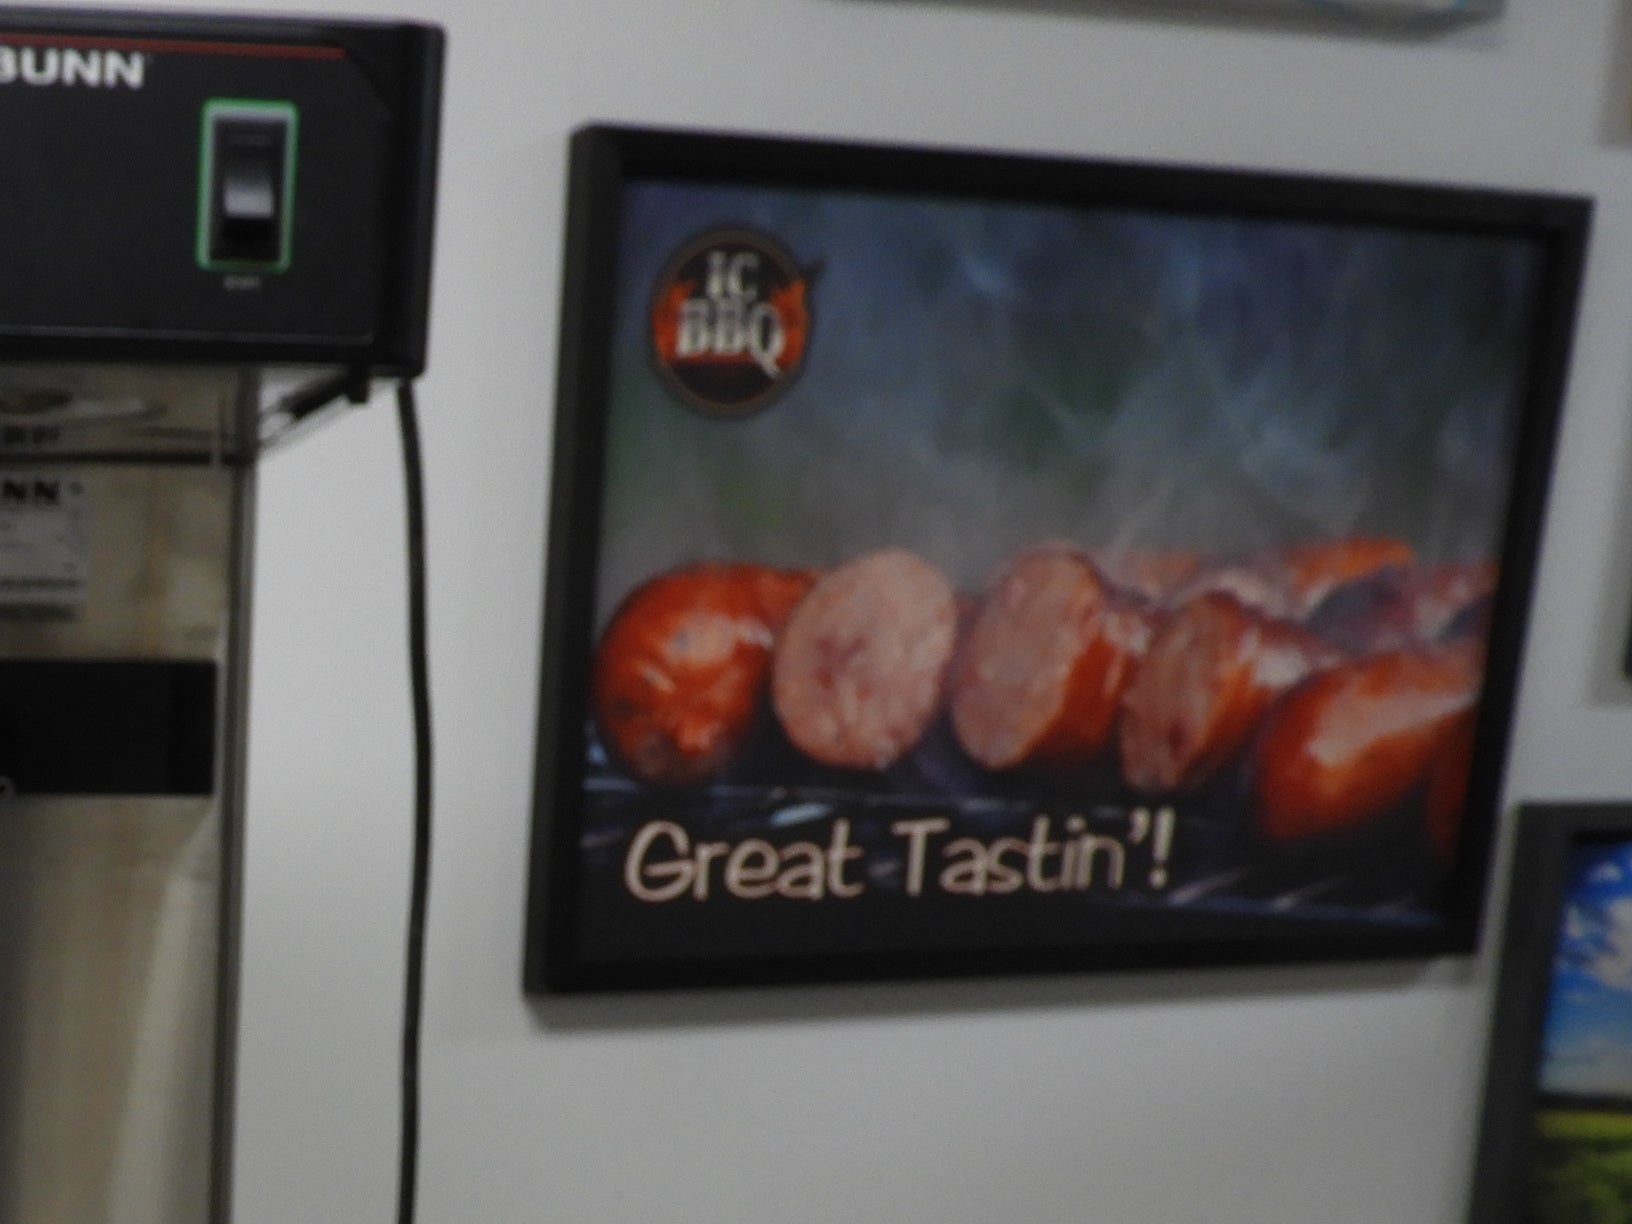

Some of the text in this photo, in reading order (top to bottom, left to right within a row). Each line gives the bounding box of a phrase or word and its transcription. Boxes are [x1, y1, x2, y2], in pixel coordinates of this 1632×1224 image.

[706, 250, 760, 300] IC
[676, 298, 787, 378] BBQ
[624, 806, 1175, 902] Great Tastin'!
